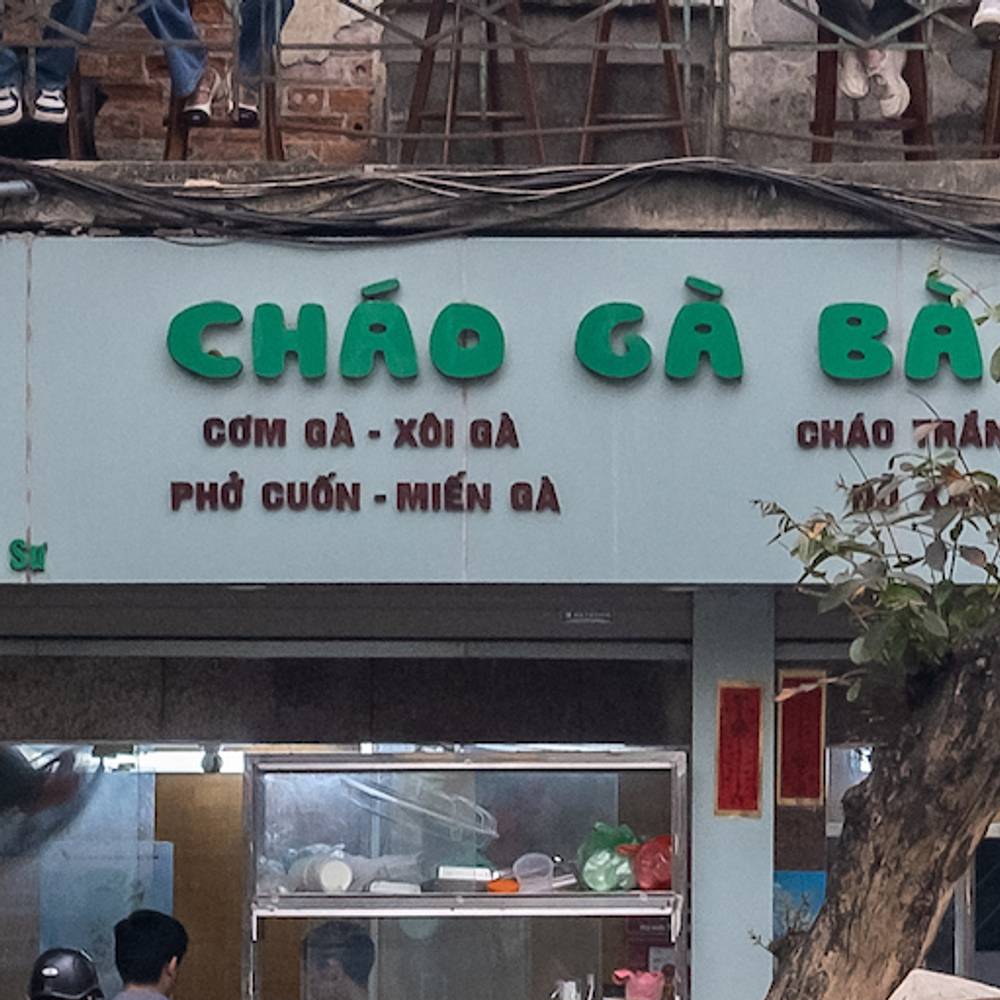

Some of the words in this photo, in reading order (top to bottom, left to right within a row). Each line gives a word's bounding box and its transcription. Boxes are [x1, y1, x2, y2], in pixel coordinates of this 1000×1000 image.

[167, 278, 506, 380] CHÁO
[575, 277, 743, 380] GÀ
[818, 274, 984, 380] BÀ
[203, 414, 287, 448] CƠM
[305, 412, 355, 448] GÀ
[394, 412, 454, 448] XÔI
[470, 412, 520, 448] GÀ
[796, 412, 894, 449] CHÁO
[170, 471, 244, 513] PHỞ
[262, 471, 361, 513] CUỐN
[396, 471, 492, 513] MIẾN
[510, 474, 561, 514] GÀ
[9, 539, 48, 572] Sư
